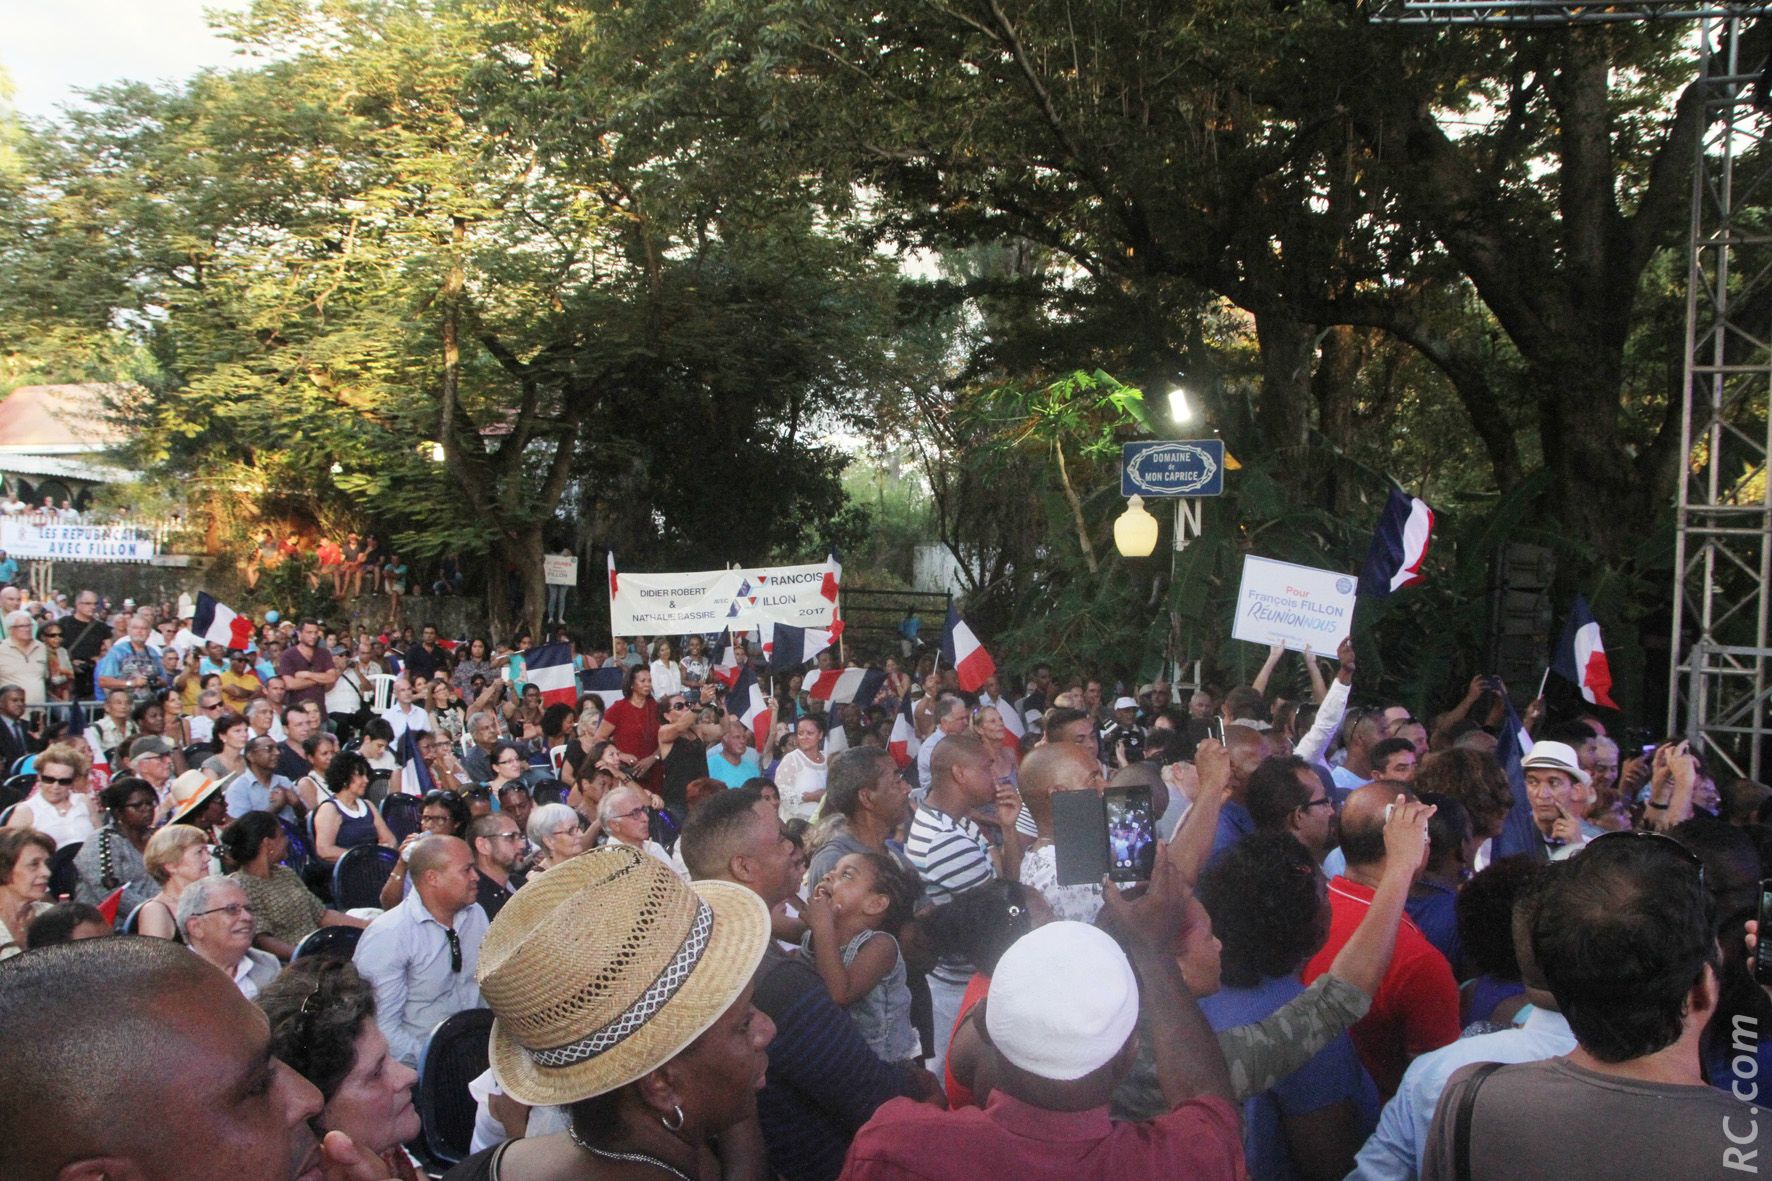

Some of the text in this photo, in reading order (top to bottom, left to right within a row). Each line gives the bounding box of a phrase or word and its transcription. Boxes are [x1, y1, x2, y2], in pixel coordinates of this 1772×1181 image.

[1153, 452, 1191, 463] DOMAINE
[1145, 471, 1198, 482] MON CAPRICE
[40, 527, 56, 539] LES
[49, 542, 81, 555] AVEC
[89, 543, 137, 556] FILLON
[640, 587, 706, 598] DIDIER ROBERT
[1286, 586, 1310, 598] Pour
[669, 600, 676, 609] &
[1248, 590, 1344, 617] François FILLON
[632, 612, 676, 622] NATHALIE
[799, 607, 826, 616] 2017
